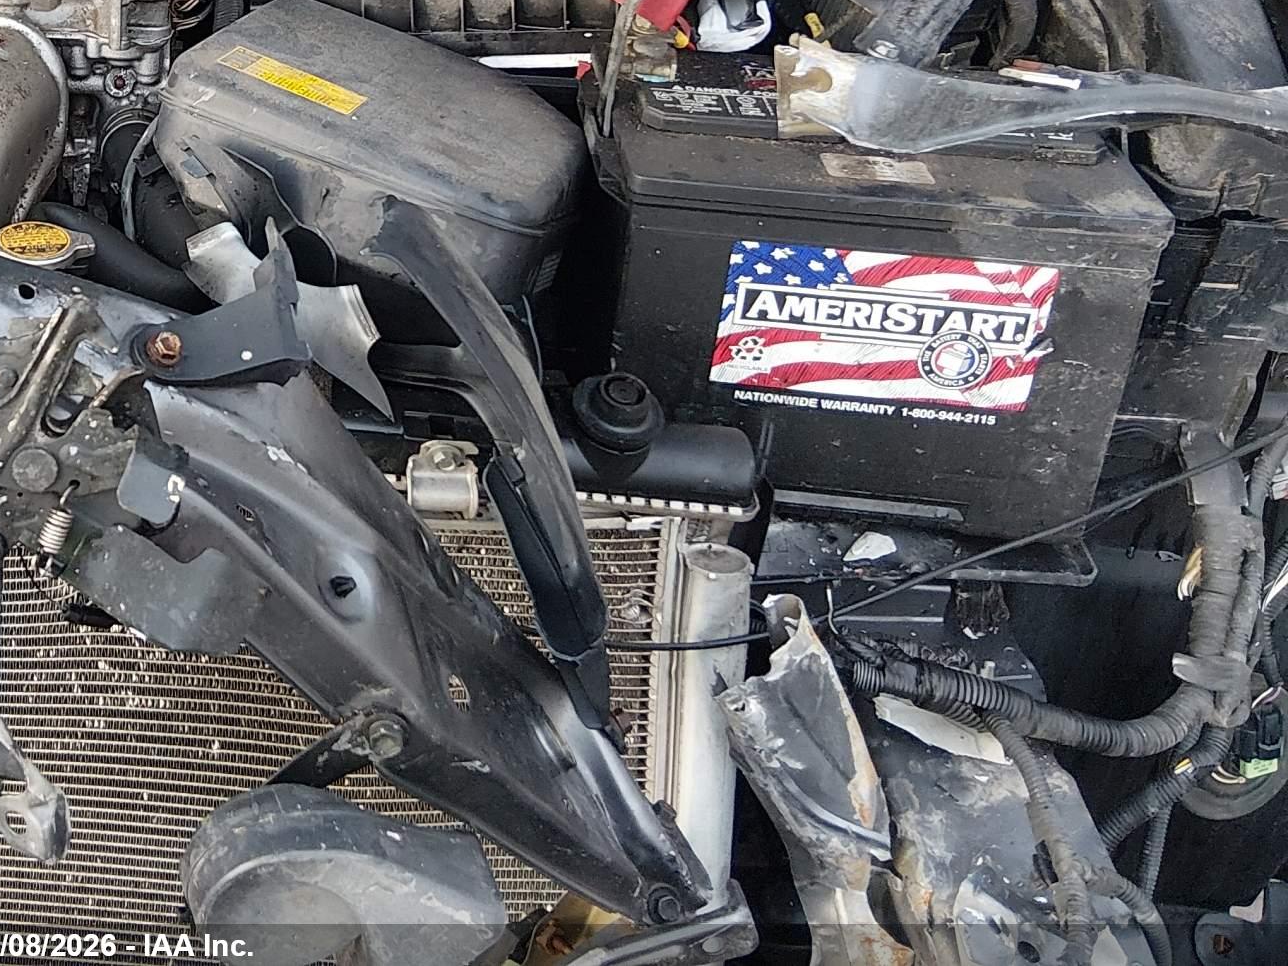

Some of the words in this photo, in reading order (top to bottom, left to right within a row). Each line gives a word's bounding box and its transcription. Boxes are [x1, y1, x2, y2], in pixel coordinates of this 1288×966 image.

[685, 85, 740, 94] DANGER
[928, 373, 965, 386] AMERICA
[734, 390, 818, 408] NATIONWIDE
[821, 399, 896, 415] WARRANTY
[901, 408, 996, 425] 1-800-944-2115
